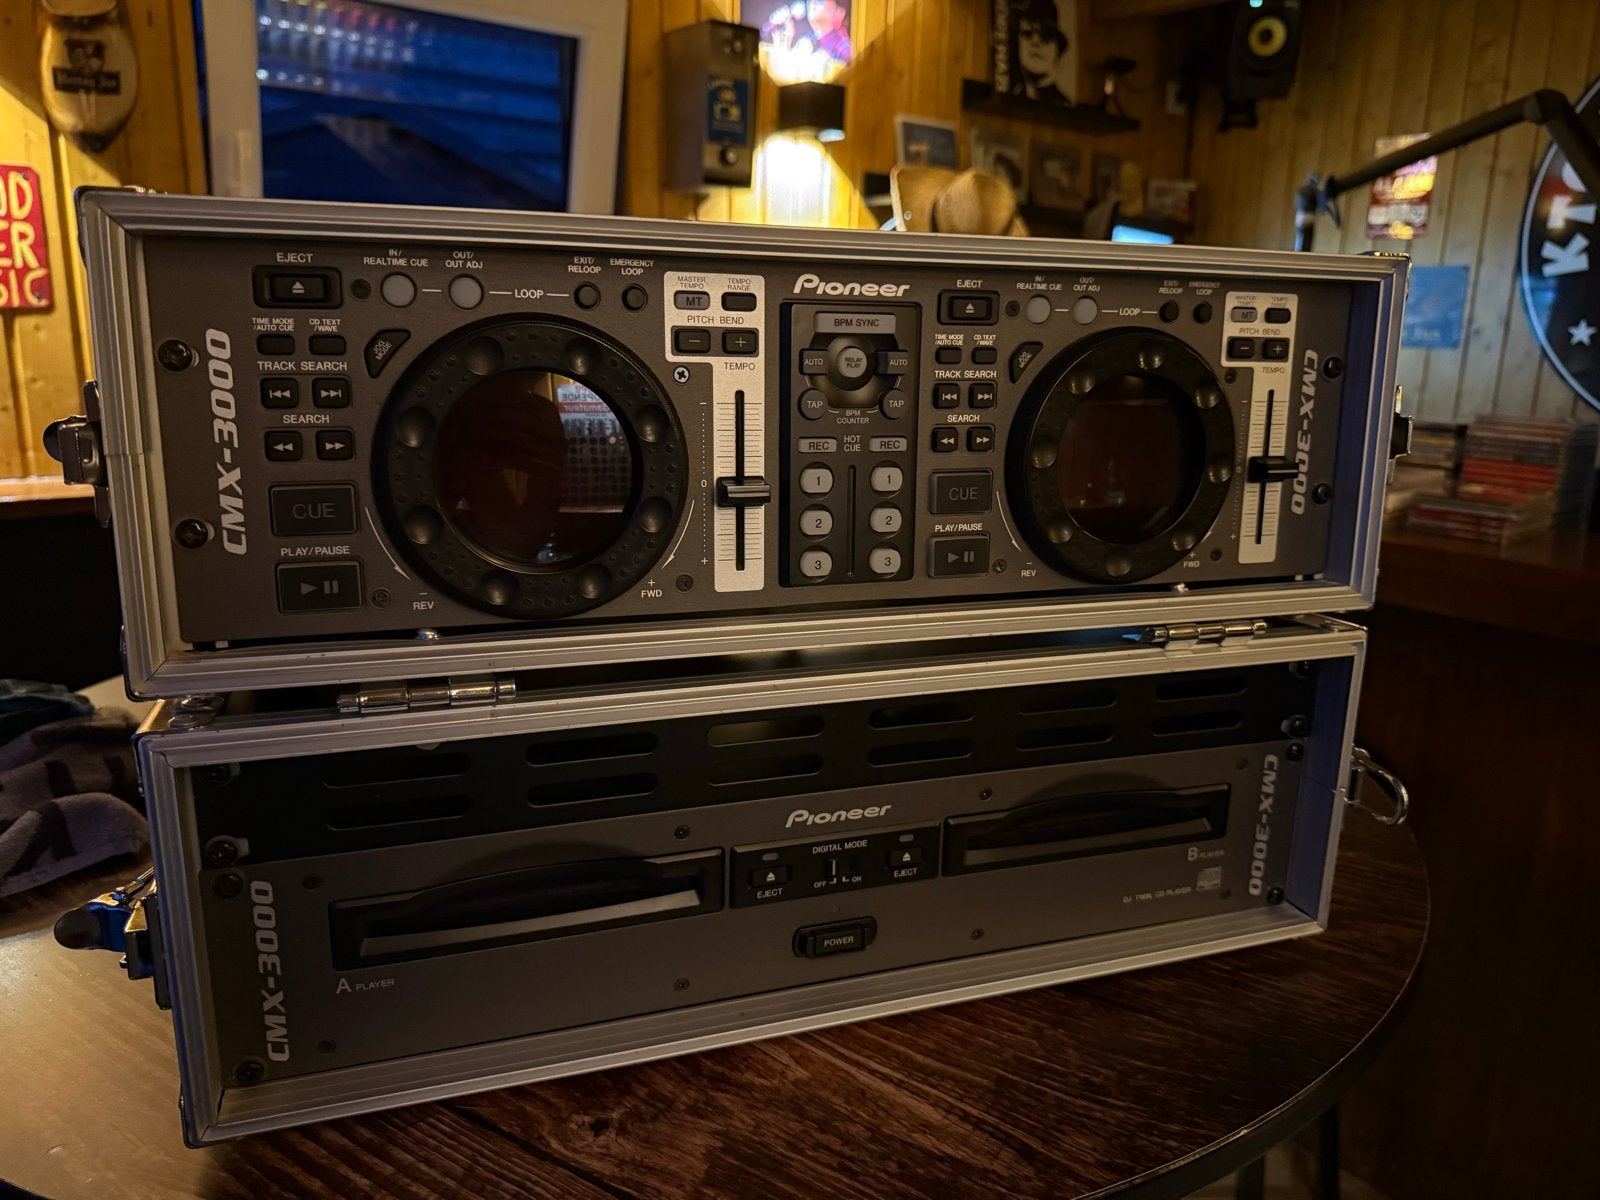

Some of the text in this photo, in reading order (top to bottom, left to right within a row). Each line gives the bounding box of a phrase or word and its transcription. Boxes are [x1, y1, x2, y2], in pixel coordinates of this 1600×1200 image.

[276, 253, 313, 263] EJECT
[453, 251, 474, 259] OUT/
[363, 257, 429, 267] REALTIME CUE
[445, 260, 483, 269] OUT ADJ
[610, 258, 654, 267] EMERGENCY
[568, 265, 601, 274] RELOOP
[621, 267, 644, 276] LOOP
[793, 273, 911, 297] Pioneer
[956, 280, 983, 288] EJECT
[1049, 283, 1062, 291] CUE
[514, 289, 544, 299] LOOP
[686, 296, 702, 306] MT
[1119, 308, 1141, 316] LOOP
[687, 315, 745, 325] PITCH BEND
[834, 318, 880, 327] BPM SYNC
[1239, 327, 1259, 335] PITCH
[376, 341, 392, 360] MODE
[257, 361, 348, 371] TRACK SEARCH
[724, 362, 756, 370] TEMPO
[934, 370, 997, 378] TRACK SEARCH
[806, 401, 823, 409] TAP
[889, 400, 904, 408] TAP
[283, 415, 330, 424] SEARCH
[1291, 349, 1319, 515] CMX-3000
[205, 328, 247, 555] CMX-3000
[808, 442, 829, 450] REC
[880, 441, 900, 449] REC
[843, 444, 861, 452] CUE
[816, 476, 821, 486] 1
[887, 475, 891, 484] 1
[949, 487, 979, 501] CUE
[292, 503, 336, 521] CUE
[815, 519, 822, 528] 2
[886, 516, 892, 525] 2
[935, 523, 983, 532] PLAY/PAUSE
[280, 545, 351, 557] PLAY/PAUSE
[815, 560, 822, 570] 3
[885, 557, 891, 566] 3
[641, 589, 663, 599] FWD
[413, 601, 435, 611] REV
[785, 804, 892, 828] Pioneer
[1249, 754, 1279, 896] CMX-3000
[812, 840, 867, 854] DIGITAL MODE
[1187, 847, 1199, 861] B
[893, 867, 918, 878] EJECT
[757, 888, 783, 898] EJECT
[1166, 886, 1191, 896] PLAYER
[824, 936, 854, 947] POWER
[250, 880, 290, 1062] CMX-3000
[336, 977, 395, 994] A PLAYER
